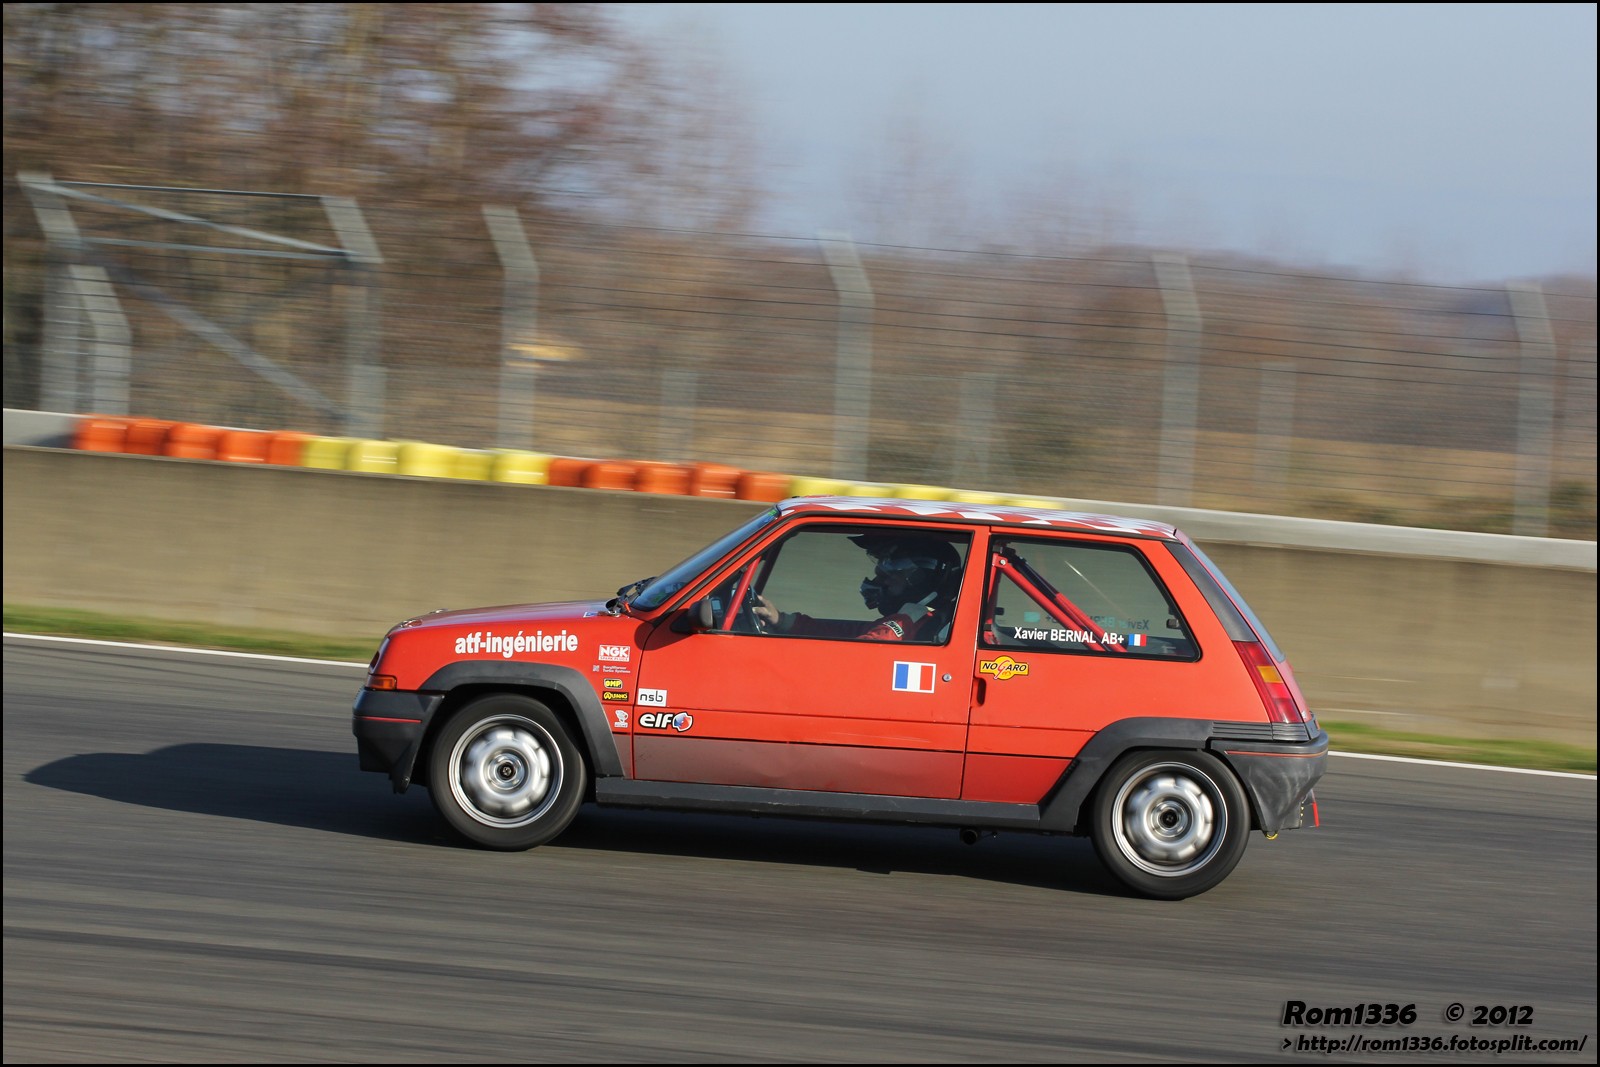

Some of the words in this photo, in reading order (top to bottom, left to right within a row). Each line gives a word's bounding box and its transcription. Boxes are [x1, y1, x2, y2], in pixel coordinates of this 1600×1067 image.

[1013, 626, 1049, 641] Xavier
[1050, 629, 1097, 644] BERNAL
[1101, 632, 1125, 645] AB+
[455, 630, 578, 659] atf-ingénierie
[600, 646, 629, 657] NGK
[982, 660, 1027, 676] NOGARO
[640, 690, 664, 702] nsb
[639, 713, 674, 728] elf
